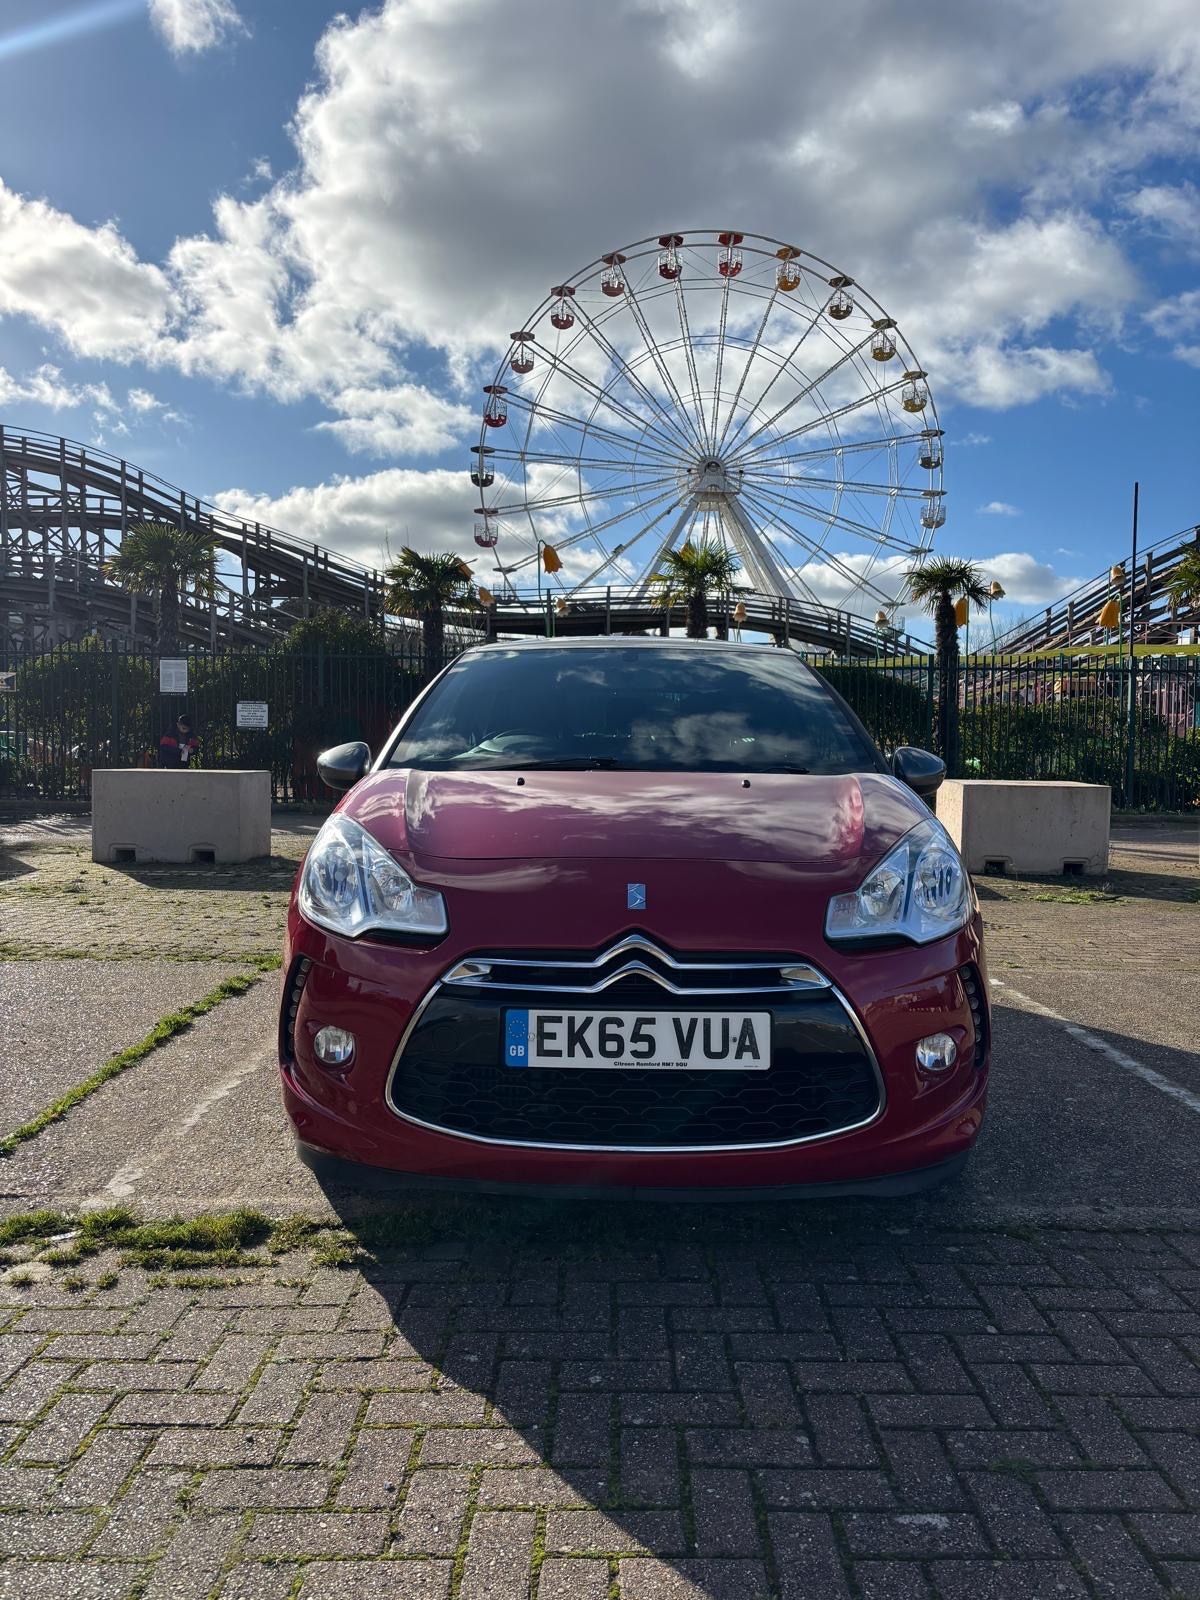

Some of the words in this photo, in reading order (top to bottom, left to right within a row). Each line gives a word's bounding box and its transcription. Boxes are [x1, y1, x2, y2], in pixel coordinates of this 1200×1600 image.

[509, 1045, 525, 1057] GB
[536, 1015, 656, 1059] EK65
[672, 1017, 761, 1060] VUA
